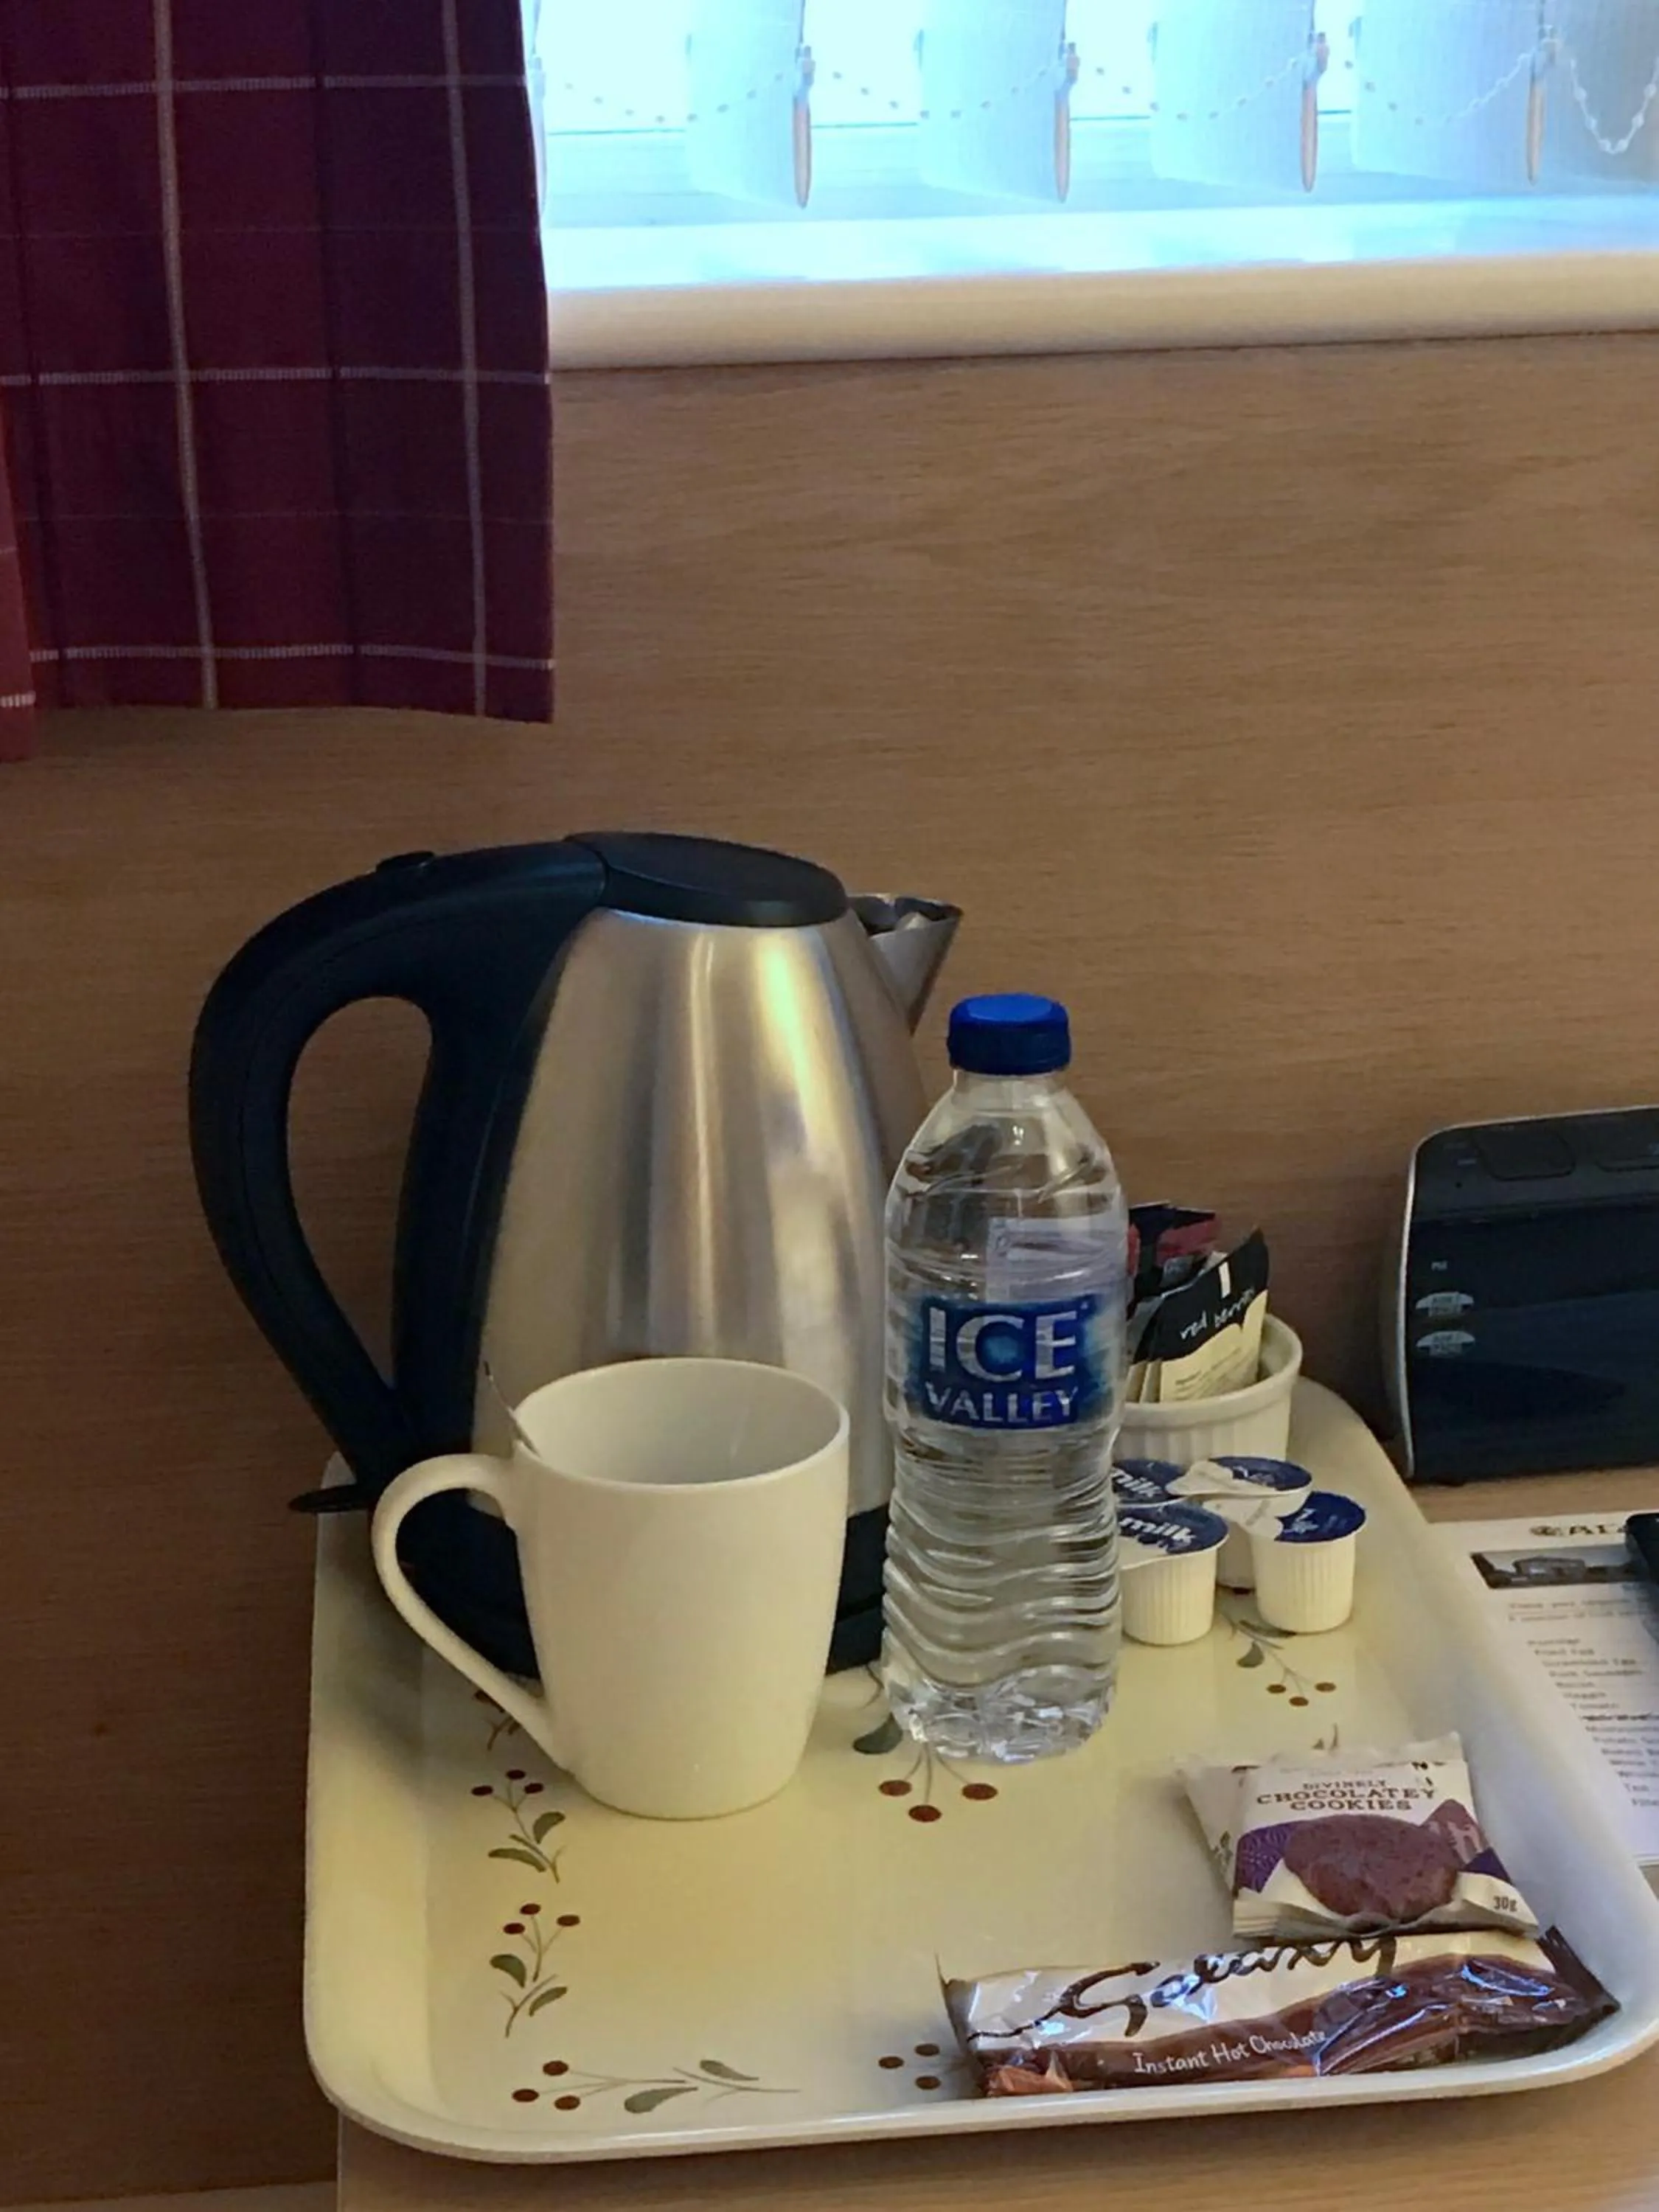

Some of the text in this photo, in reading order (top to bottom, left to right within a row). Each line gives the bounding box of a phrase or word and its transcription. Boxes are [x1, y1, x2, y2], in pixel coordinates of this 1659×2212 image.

[929, 1307, 1077, 1382] ICE
[924, 1380, 1079, 1423] VALLEY
[1119, 1517, 1197, 1543] milk
[1256, 1787, 1435, 1805] CHOCOLATEY
[1290, 1799, 1412, 1811] COOKIES
[1493, 1895, 1517, 1913] 30g
[1133, 2029, 1326, 2075] Instant Hot Chocolate
